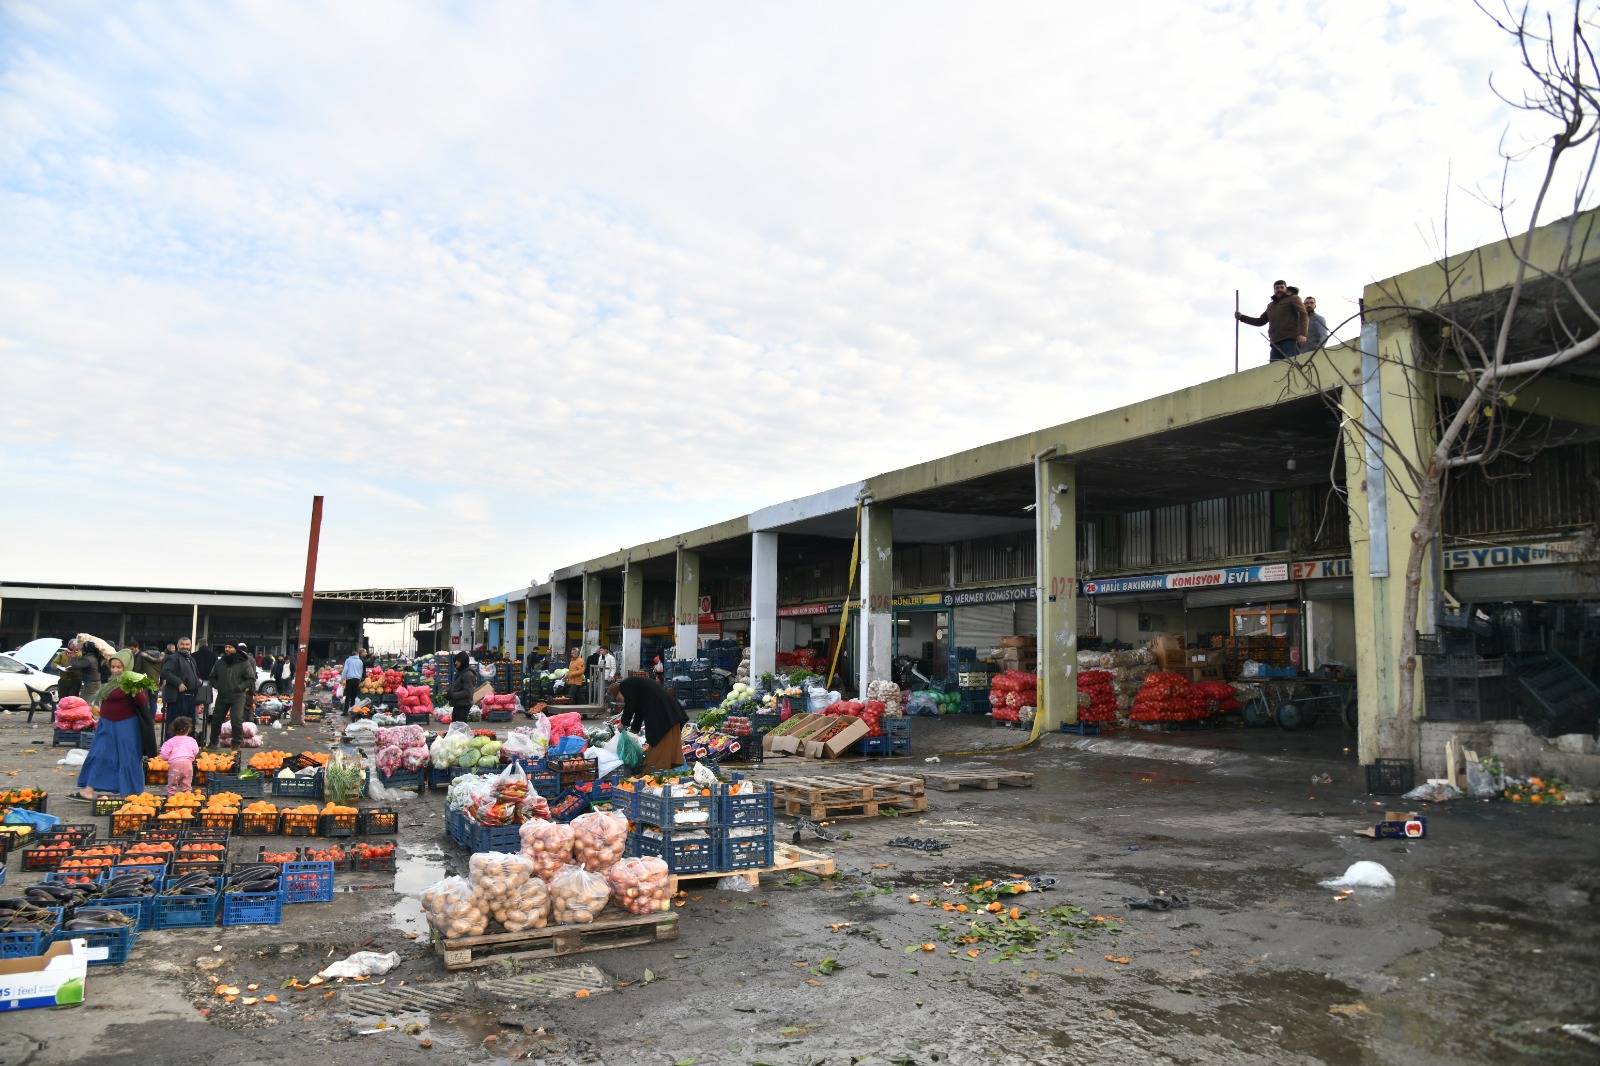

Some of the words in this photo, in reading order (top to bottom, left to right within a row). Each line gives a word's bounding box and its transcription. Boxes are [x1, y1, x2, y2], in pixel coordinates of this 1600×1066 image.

[1444, 544, 1530, 569] iSYON
[1292, 562, 1316, 579] 27
[1322, 559, 1352, 577] KIL
[1051, 576, 1073, 599] 027
[1086, 583, 1096, 593] 26
[1101, 580, 1120, 593] HALİL
[1122, 579, 1162, 591] BAKIRHAN
[1172, 573, 1220, 587] KOMİSYON
[1227, 568, 1249, 584] EVİ
[955, 592, 984, 604] MERMER
[17, 985, 37, 996] feel
